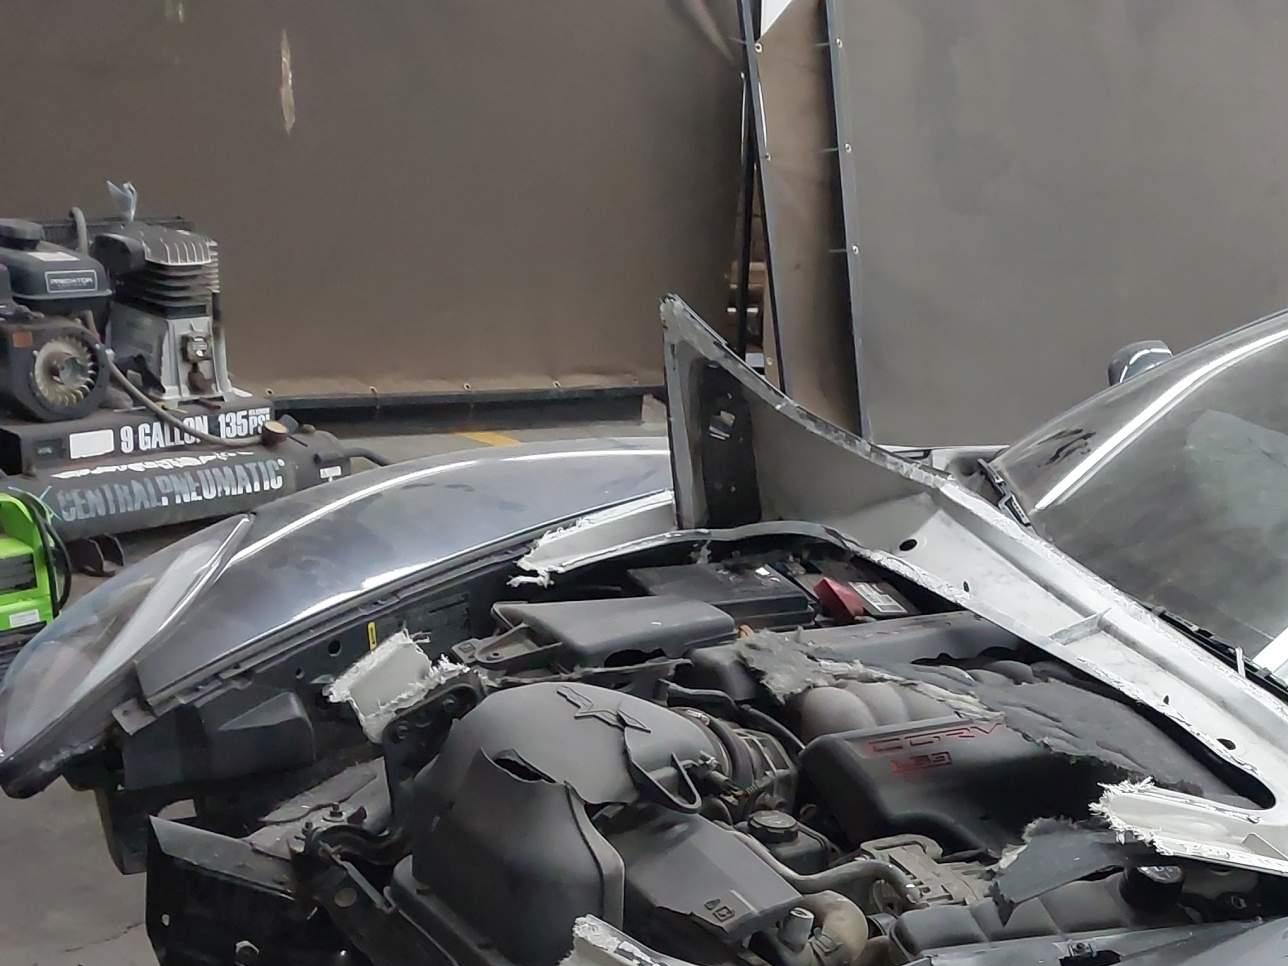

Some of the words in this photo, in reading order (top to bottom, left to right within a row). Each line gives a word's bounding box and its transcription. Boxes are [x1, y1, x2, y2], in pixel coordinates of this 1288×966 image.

[120, 426, 134, 453] 9
[138, 415, 208, 450] GALLON
[218, 409, 248, 438] 135
